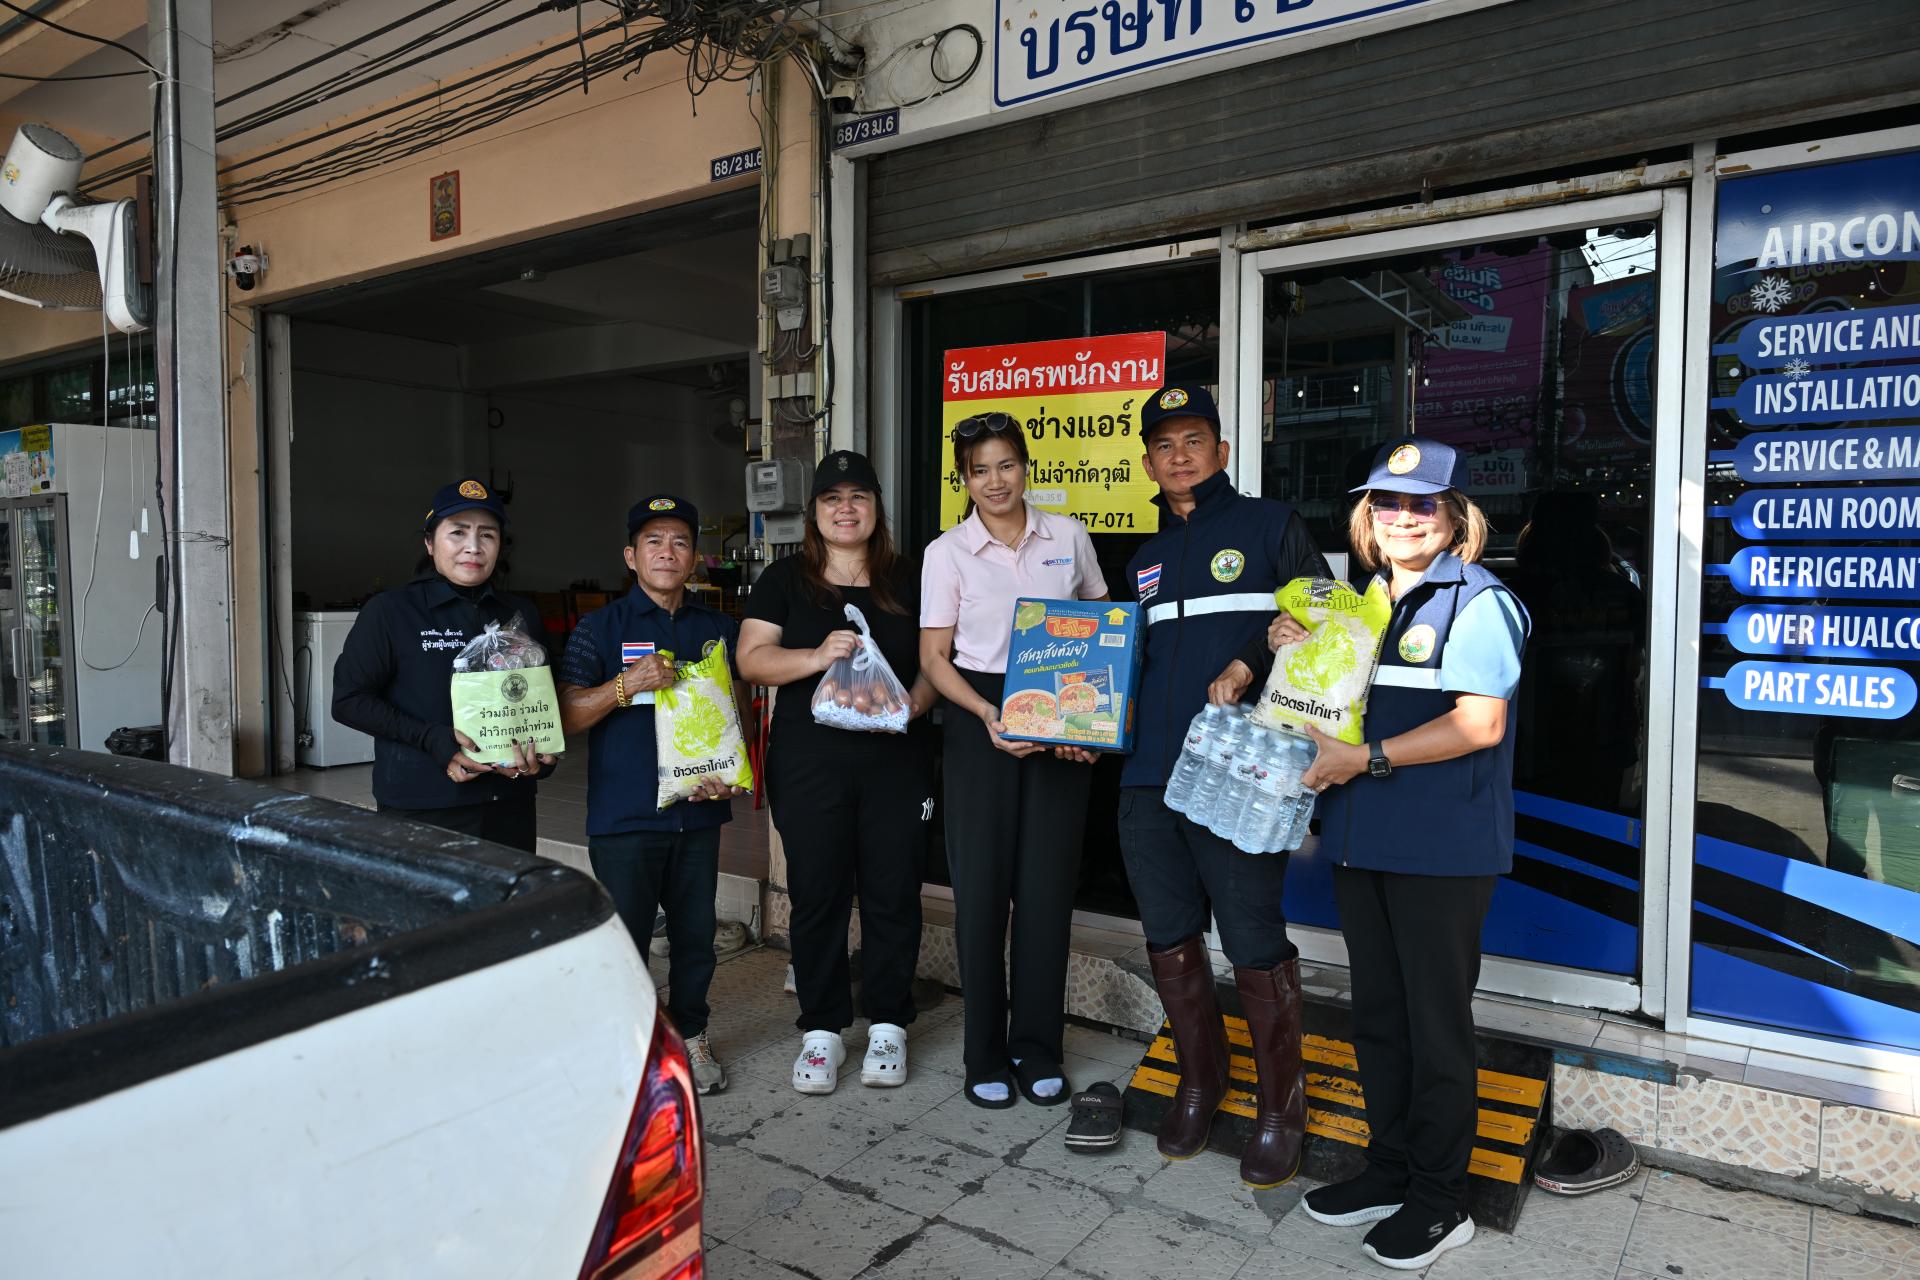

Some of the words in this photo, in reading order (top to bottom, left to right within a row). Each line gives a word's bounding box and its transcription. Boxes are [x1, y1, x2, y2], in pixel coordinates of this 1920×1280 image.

[836, 121, 869, 145] 68/3
[871, 115, 894, 135] ม.6
[714, 156, 742, 178] 68/2
[1758, 319, 1864, 358] SERVICE
[948, 350, 1159, 395] รับสมัครพนักงาน
[1755, 374, 1920, 415] INSTALLATIO
[1026, 398, 1134, 441] ช่างแอร์
[1753, 439, 1859, 472] SERVICE
[1030, 459, 1131, 492] ไม่จำกัดวุฒิ
[1752, 498, 1833, 530] CLEAN
[1841, 496, 1920, 529] ROOM
[1747, 613, 1815, 646] OVER
[1270, 689, 1343, 722] ข้าวตราไก่แจ้
[1744, 669, 1811, 704] PART
[1814, 673, 1896, 709] SALES
[480, 705, 517, 719] ร่วมมือ
[519, 700, 549, 716] ร่วมใจ
[673, 756, 736, 779] ข้าวตราไก่แจ้
